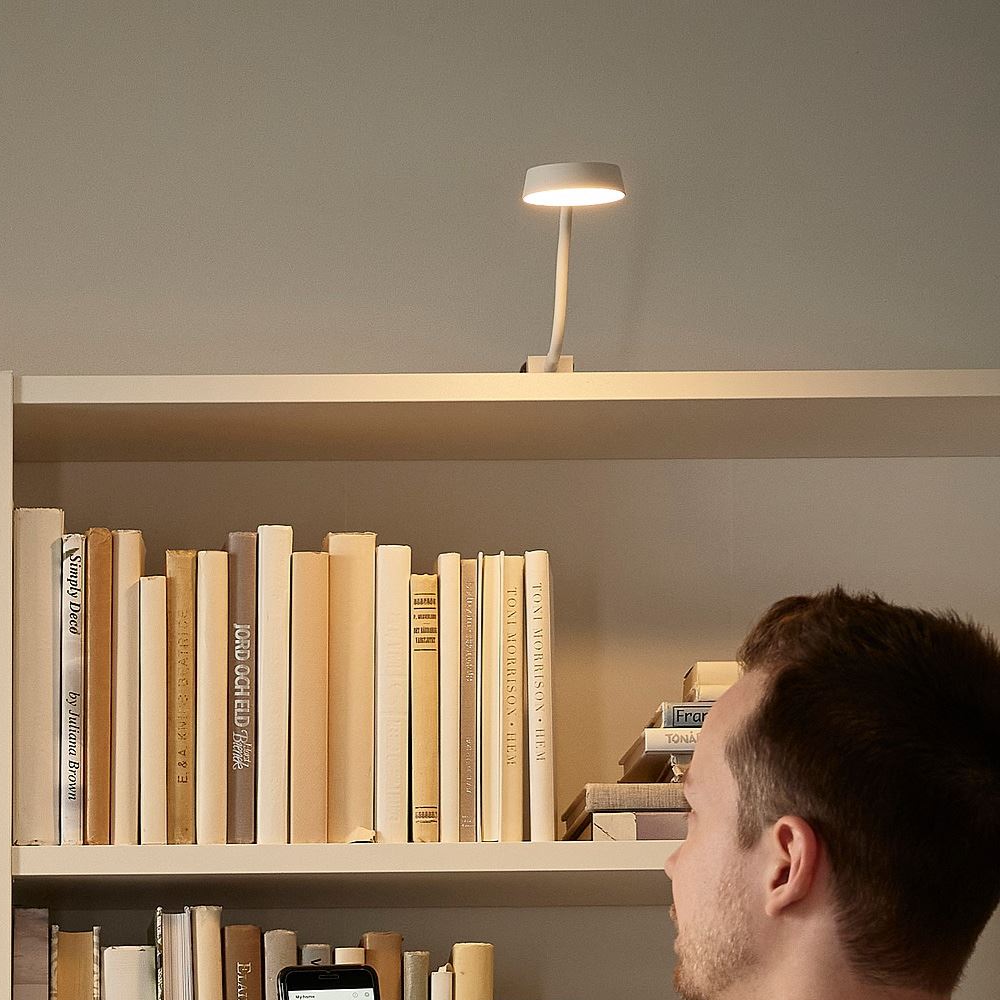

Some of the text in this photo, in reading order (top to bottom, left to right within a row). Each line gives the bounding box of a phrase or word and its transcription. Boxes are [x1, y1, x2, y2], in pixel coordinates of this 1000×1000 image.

[67, 555, 82, 598] Simply
[233, 623, 251, 727] JORD OCH ELD
[506, 587, 517, 766] TONI MORRISON HEM
[532, 582, 546, 762] TONI MORRISON HEM
[66, 691, 80, 801] by Juliana Brown
